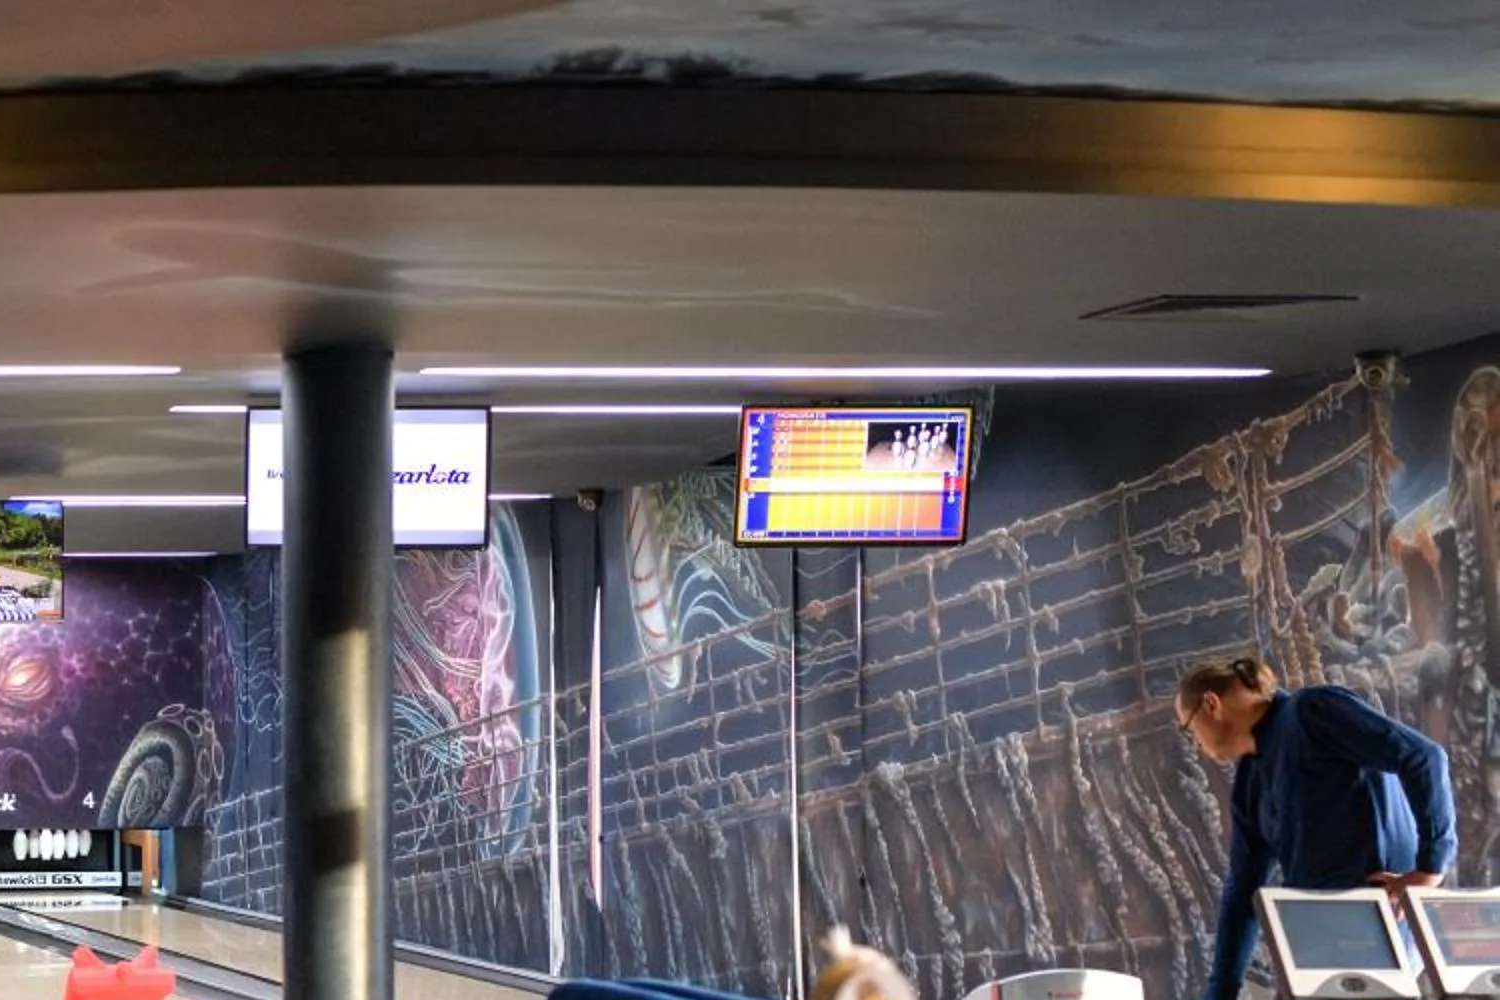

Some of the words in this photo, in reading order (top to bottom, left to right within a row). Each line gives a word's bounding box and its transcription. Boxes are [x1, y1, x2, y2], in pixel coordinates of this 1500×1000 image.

[390, 463, 470, 485] zarlota
[82, 791, 96, 809] 4
[51, 873, 84, 885] GSX
